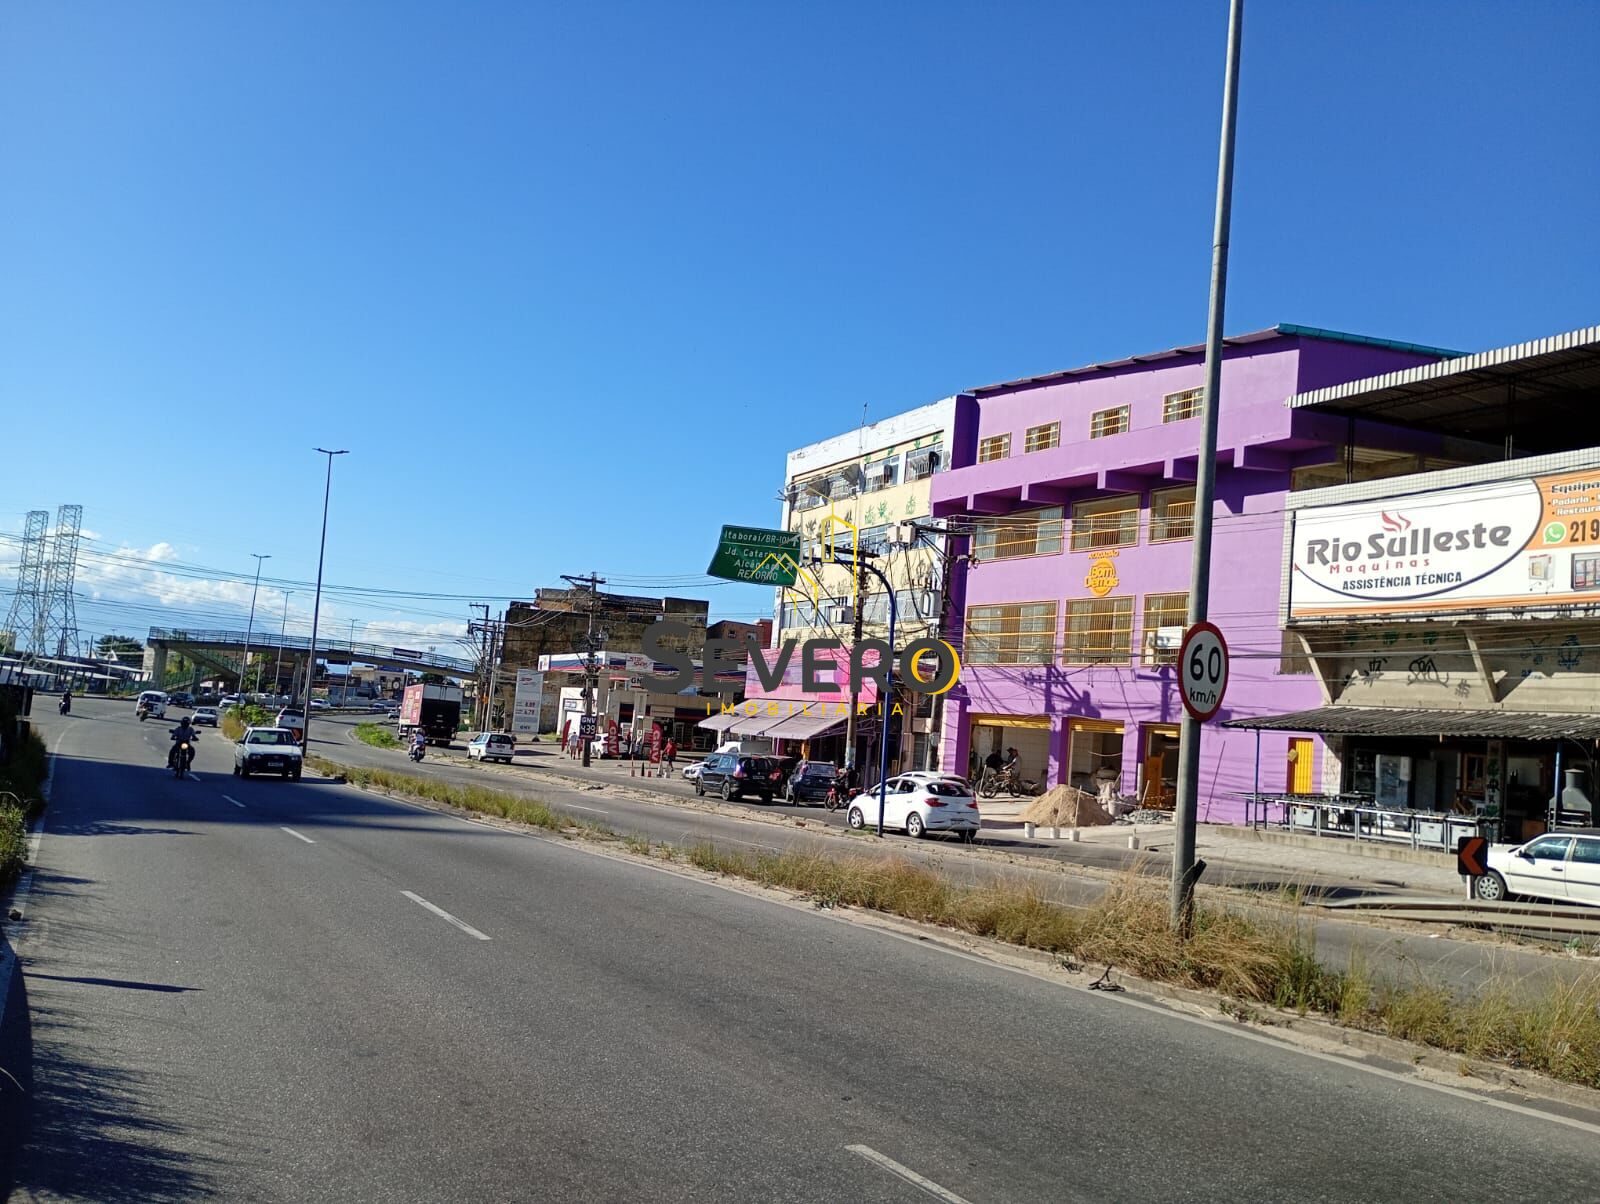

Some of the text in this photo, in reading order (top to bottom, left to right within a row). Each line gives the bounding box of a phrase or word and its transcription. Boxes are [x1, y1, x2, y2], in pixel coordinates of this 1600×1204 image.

[1552, 496, 1590, 506] Padaria
[1569, 519, 1587, 542] 21
[724, 547, 739, 556] Jd.
[1307, 523, 1512, 566] Rio Sulleste
[737, 569, 779, 581] RETORNO
[1329, 558, 1430, 574] Maquinas
[1342, 571, 1462, 591] ASSISTÊNCIA TÉCNICA
[1190, 644, 1221, 684] 60
[1189, 688, 1217, 704] km/h
[609, 726, 618, 754] GNV
[651, 730, 660, 762] GNV
